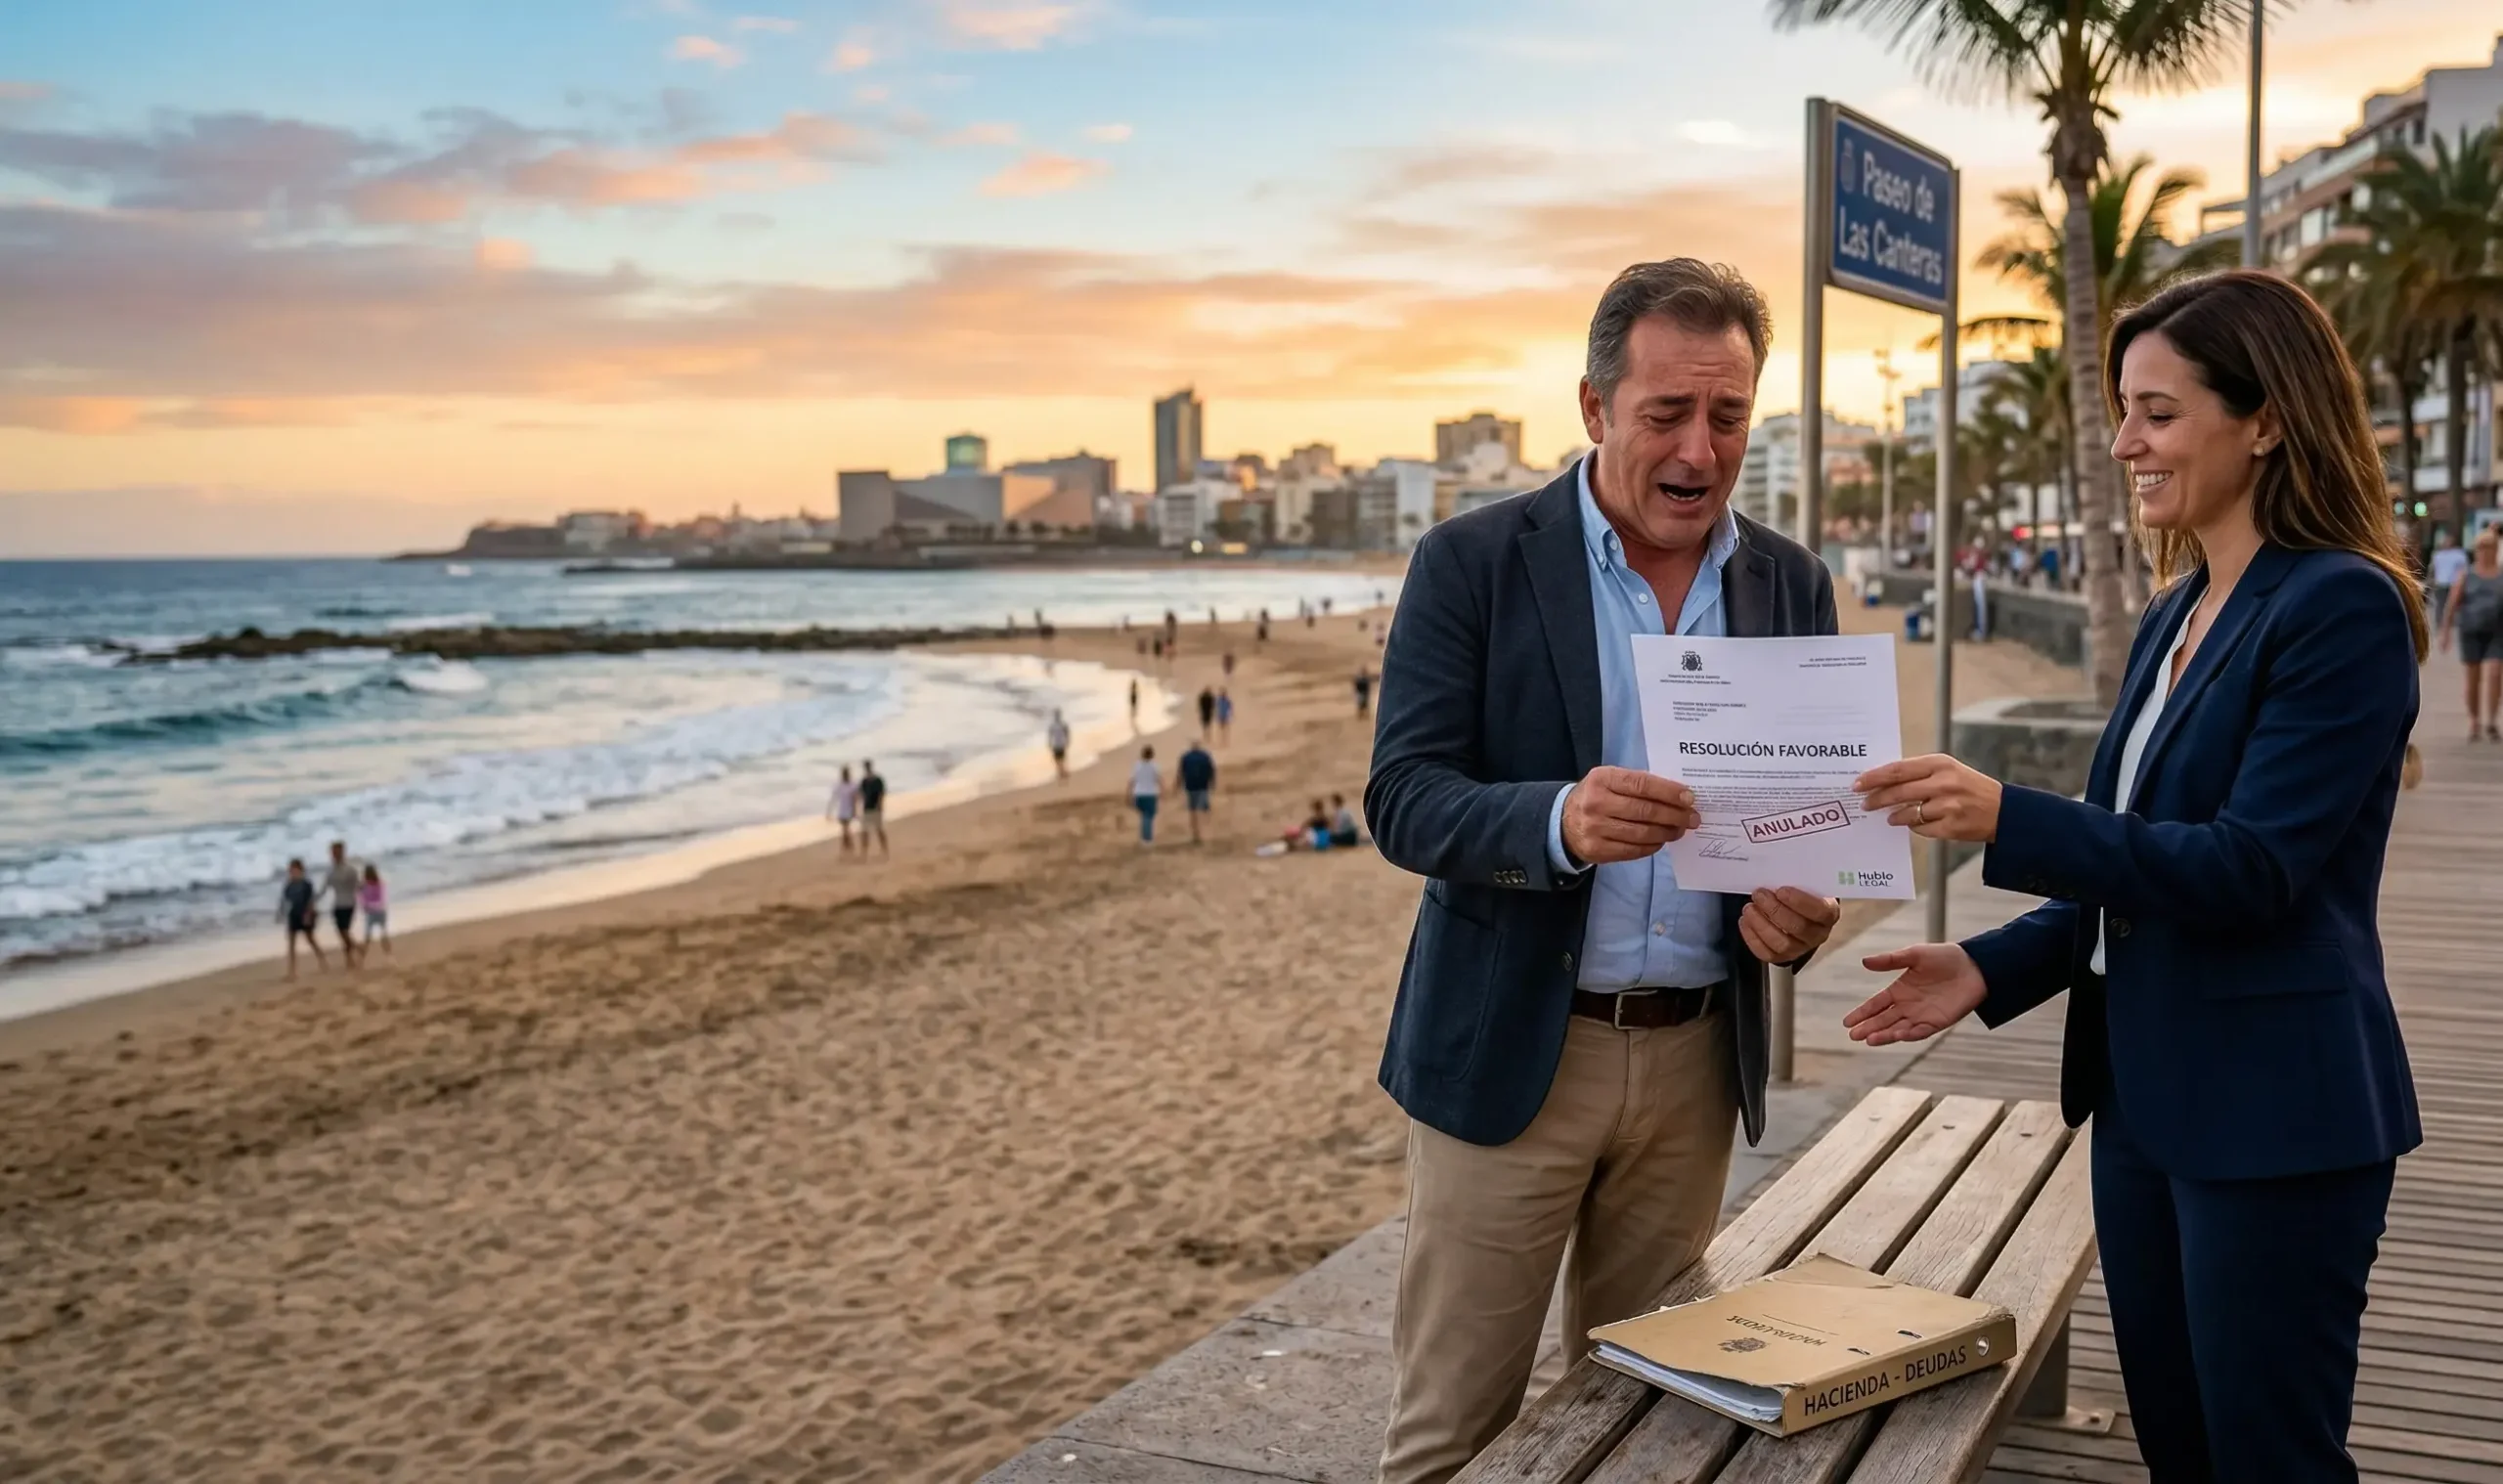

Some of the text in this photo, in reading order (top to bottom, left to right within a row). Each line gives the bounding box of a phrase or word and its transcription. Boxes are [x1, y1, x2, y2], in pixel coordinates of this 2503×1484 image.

[1863, 151, 1934, 224] Paseo de
[1839, 205, 1943, 285] Las Canteras
[1679, 741, 1867, 758] RESOLUCIÓN FAVORABLE
[1753, 808, 1840, 838] ANULADO
[1858, 871, 1894, 881] Hublo
[1804, 1372, 1890, 1416] HACIENDA
[1906, 1345, 1967, 1382] DEUDAS
